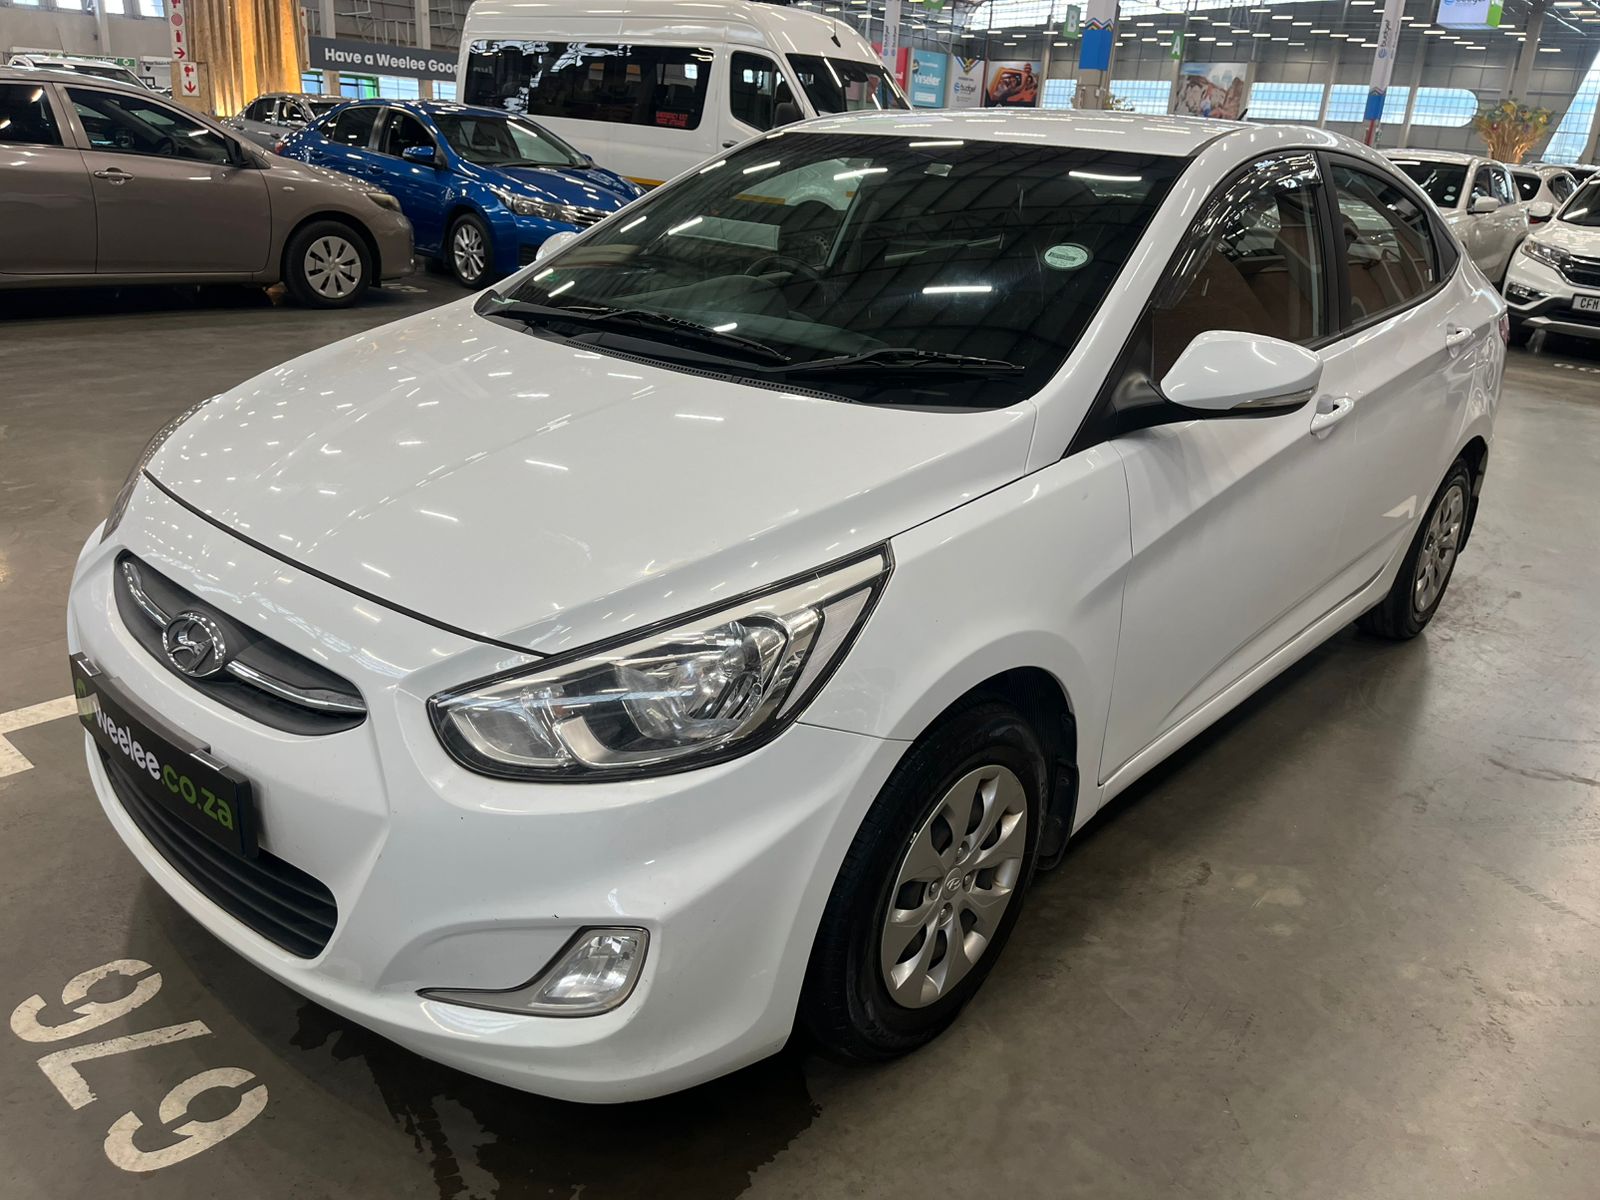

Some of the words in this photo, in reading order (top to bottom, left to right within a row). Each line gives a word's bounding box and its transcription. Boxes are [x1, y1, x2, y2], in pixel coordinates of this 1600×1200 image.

[1067, 9, 1078, 33] B
[1171, 35, 1181, 56] A
[325, 48, 362, 64] Have
[364, 54, 374, 66] a
[376, 53, 426, 71] Weelee
[1580, 297, 1599, 310] CFM
[92, 701, 234, 831] weelee.co.za
